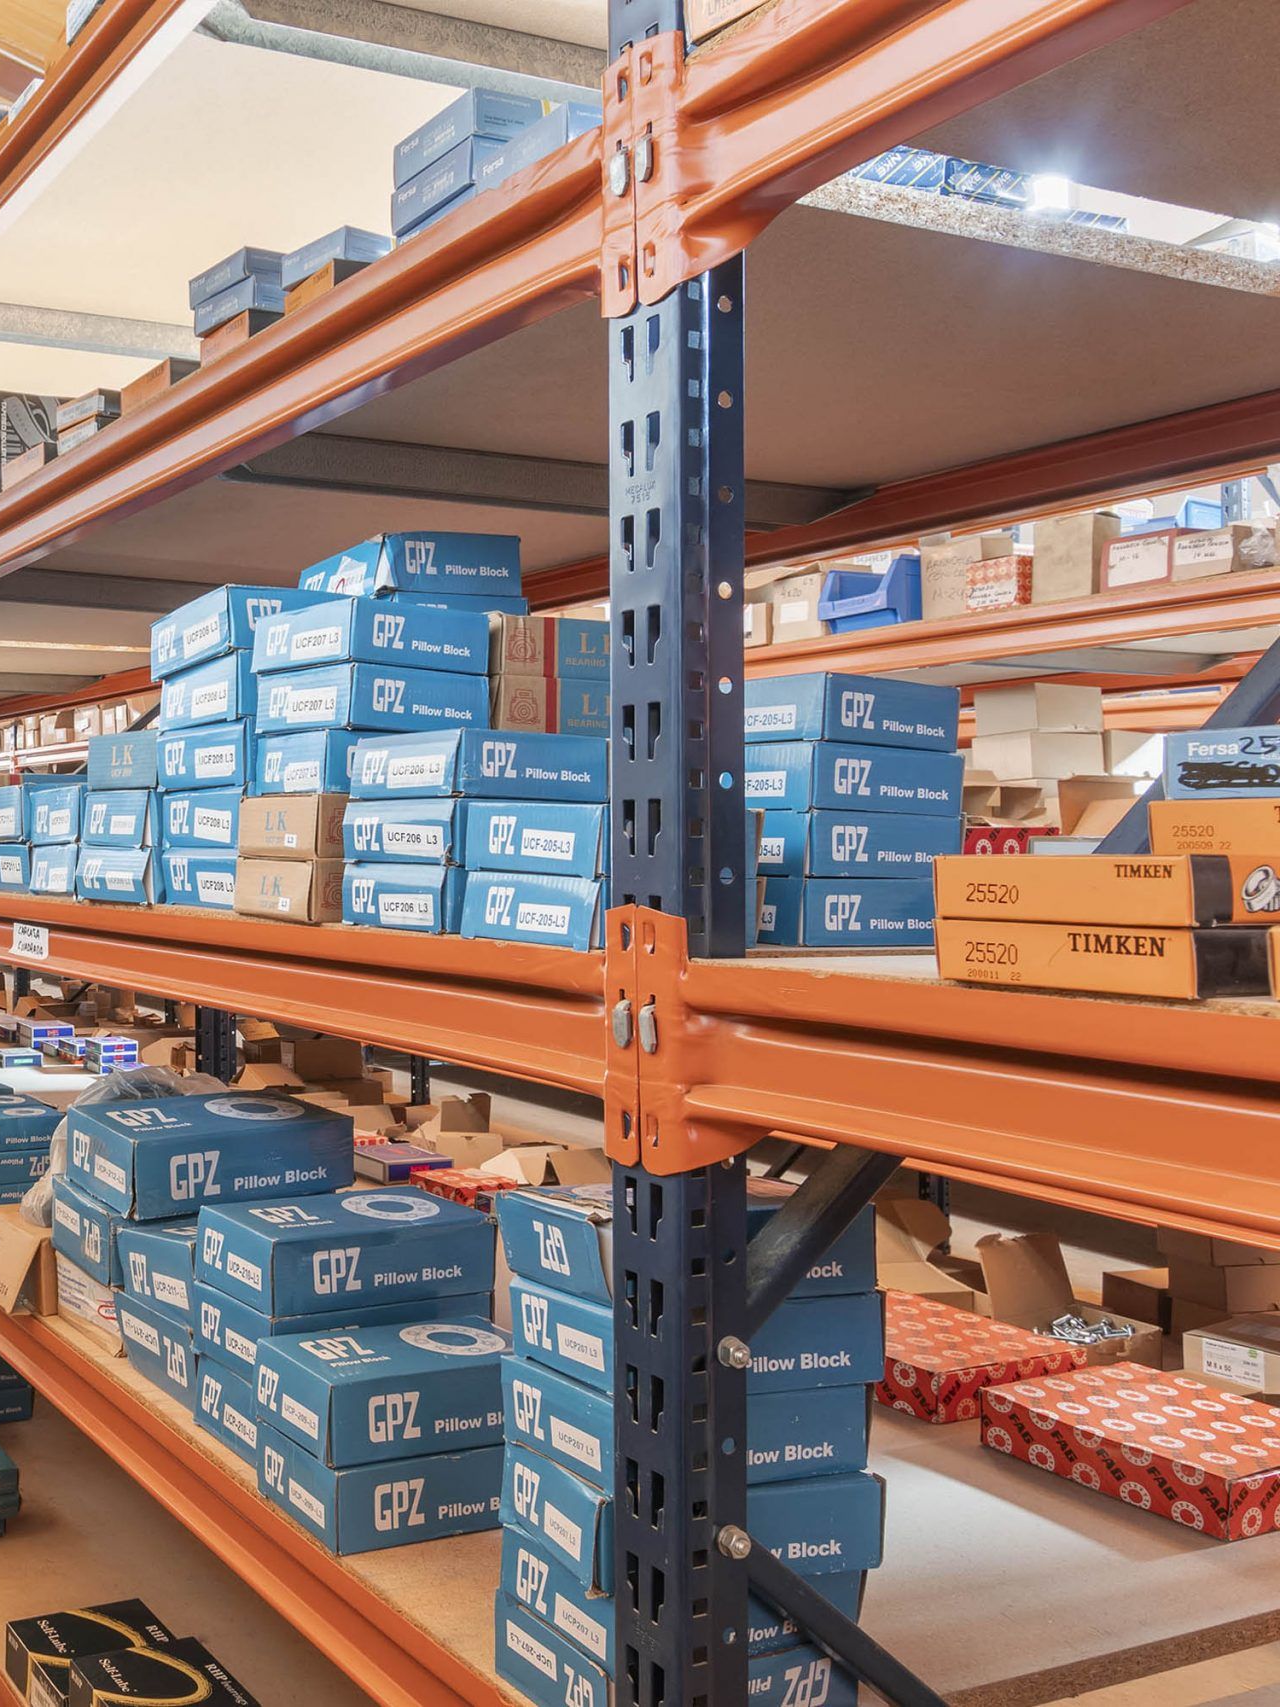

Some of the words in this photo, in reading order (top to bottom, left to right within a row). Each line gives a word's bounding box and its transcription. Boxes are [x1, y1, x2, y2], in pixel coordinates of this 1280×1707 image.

[373, 613, 405, 649] GPZ
[412, 640, 441, 653] Pillow
[443, 643, 471, 657] Block
[373, 678, 405, 713] GPZ
[412, 704, 441, 718] Pillow
[444, 707, 472, 720] Block
[841, 690, 876, 730] GPZ
[882, 720, 914, 735] Pillow
[916, 723, 946, 738] Block
[745, 712, 794, 729] CF-205-L3
[482, 741, 517, 779] GPZ
[525, 767, 558, 781] Pillow
[561, 770, 591, 783] Block
[1187, 741, 1239, 757] Fersa
[833, 757, 872, 796] GPZ
[880, 785, 914, 799] Pillow
[917, 788, 950, 801] Block
[170, 801, 190, 835] GPZ
[488, 815, 517, 855] GPZ
[1172, 825, 1215, 838] 25520
[831, 824, 869, 863] GPZ
[877, 850, 912, 864] Pillow
[1114, 863, 1173, 879] TIMKEN
[485, 886, 516, 926] GPZ
[966, 882, 1020, 905] 25520
[964, 941, 1019, 966] 25520
[1067, 932, 1167, 958] TIMKEN
[106, 1107, 177, 1127] GPZ
[169, 1150, 221, 1201] GPZ
[233, 1174, 280, 1192] Pillow
[284, 1166, 328, 1185] Block
[248, 1205, 320, 1224] GPZ
[532, 1220, 571, 1277] GPZ
[312, 1247, 362, 1296] GPZ
[373, 1271, 418, 1287] Pillow
[421, 1264, 463, 1281] Block
[163, 1335, 188, 1389] GPZ
[298, 1336, 376, 1360] GPZ
[799, 1350, 852, 1370] Block
[368, 1391, 421, 1444] GPZ
[434, 1415, 482, 1434] Pillow
[512, 1378, 545, 1441] GPZ
[558, 1432, 585, 1452] UCP207
[784, 1442, 835, 1463] Block
[1049, 1429, 1076, 1464] FAG
[1095, 1447, 1126, 1483] FAG
[373, 1478, 425, 1532] GPZ
[437, 1501, 486, 1520] Pillow
[787, 1539, 843, 1560] Block
[515, 1547, 549, 1616] GPZ
[144, 1623, 170, 1644] RHP
[203, 1662, 228, 1683] RHP
